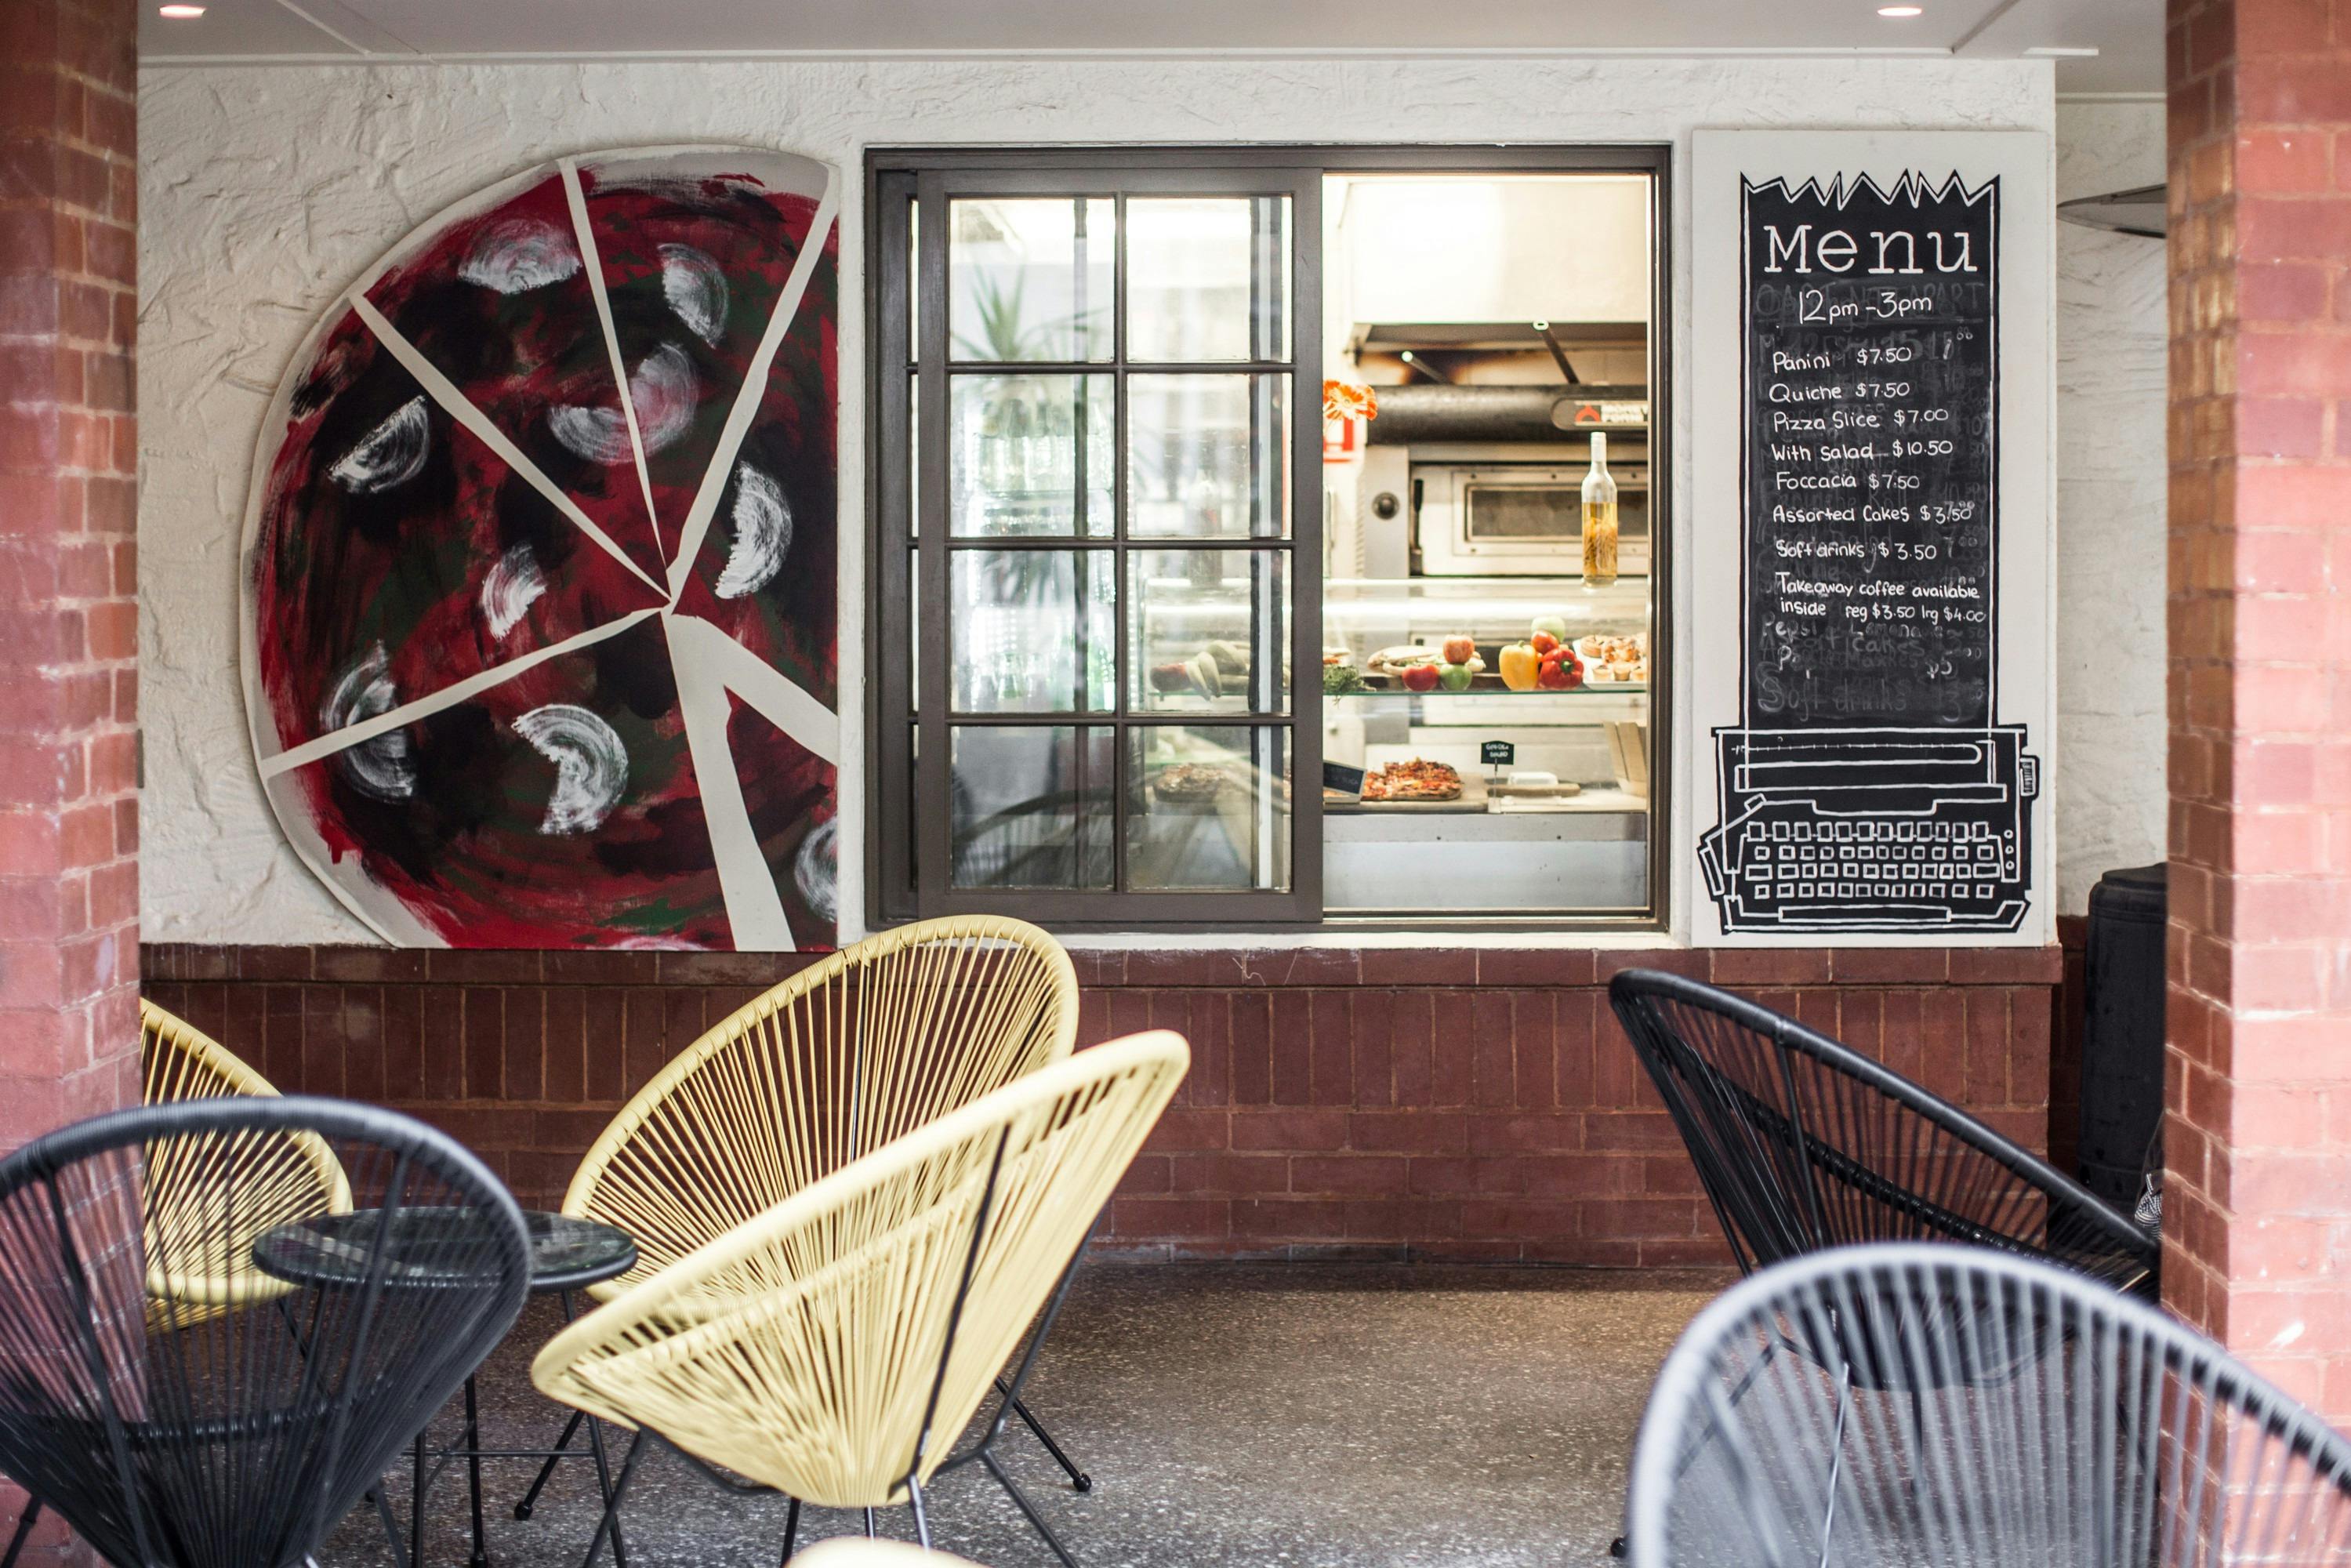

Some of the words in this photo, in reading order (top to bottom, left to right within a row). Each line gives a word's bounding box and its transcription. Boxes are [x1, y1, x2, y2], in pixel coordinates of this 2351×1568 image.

[1763, 224, 1978, 274] Menu
[1772, 350, 1830, 374] Panini
[1856, 347, 1912, 366] $7.50
[1769, 383, 1842, 403] Quiche
[1855, 382, 1910, 398] $7.50
[1773, 411, 1826, 433] Pizza
[1831, 410, 1881, 430] Slice
[1893, 408, 1949, 427] $7.00
[1771, 443, 1812, 462] With
[1892, 438, 1954, 459] $10.50
[1776, 471, 1857, 491] Foccacia
[1868, 473, 1920, 490] $7.50
[1772, 504, 1856, 523] Assorted
[1863, 504, 1910, 522] Cakes
[1920, 506, 1972, 524] $3.50
[1878, 541, 1937, 561] $3.50
[1774, 571, 1854, 597] Takeaway
[1859, 579, 1905, 597] coffee
[1911, 583, 1980, 599] available
[1780, 597, 1827, 616] inside
[1845, 605, 1868, 623] reg
[1872, 601, 1915, 620] $3.50
[1921, 604, 1939, 626] lrg
[1943, 606, 1986, 622] $4.00
